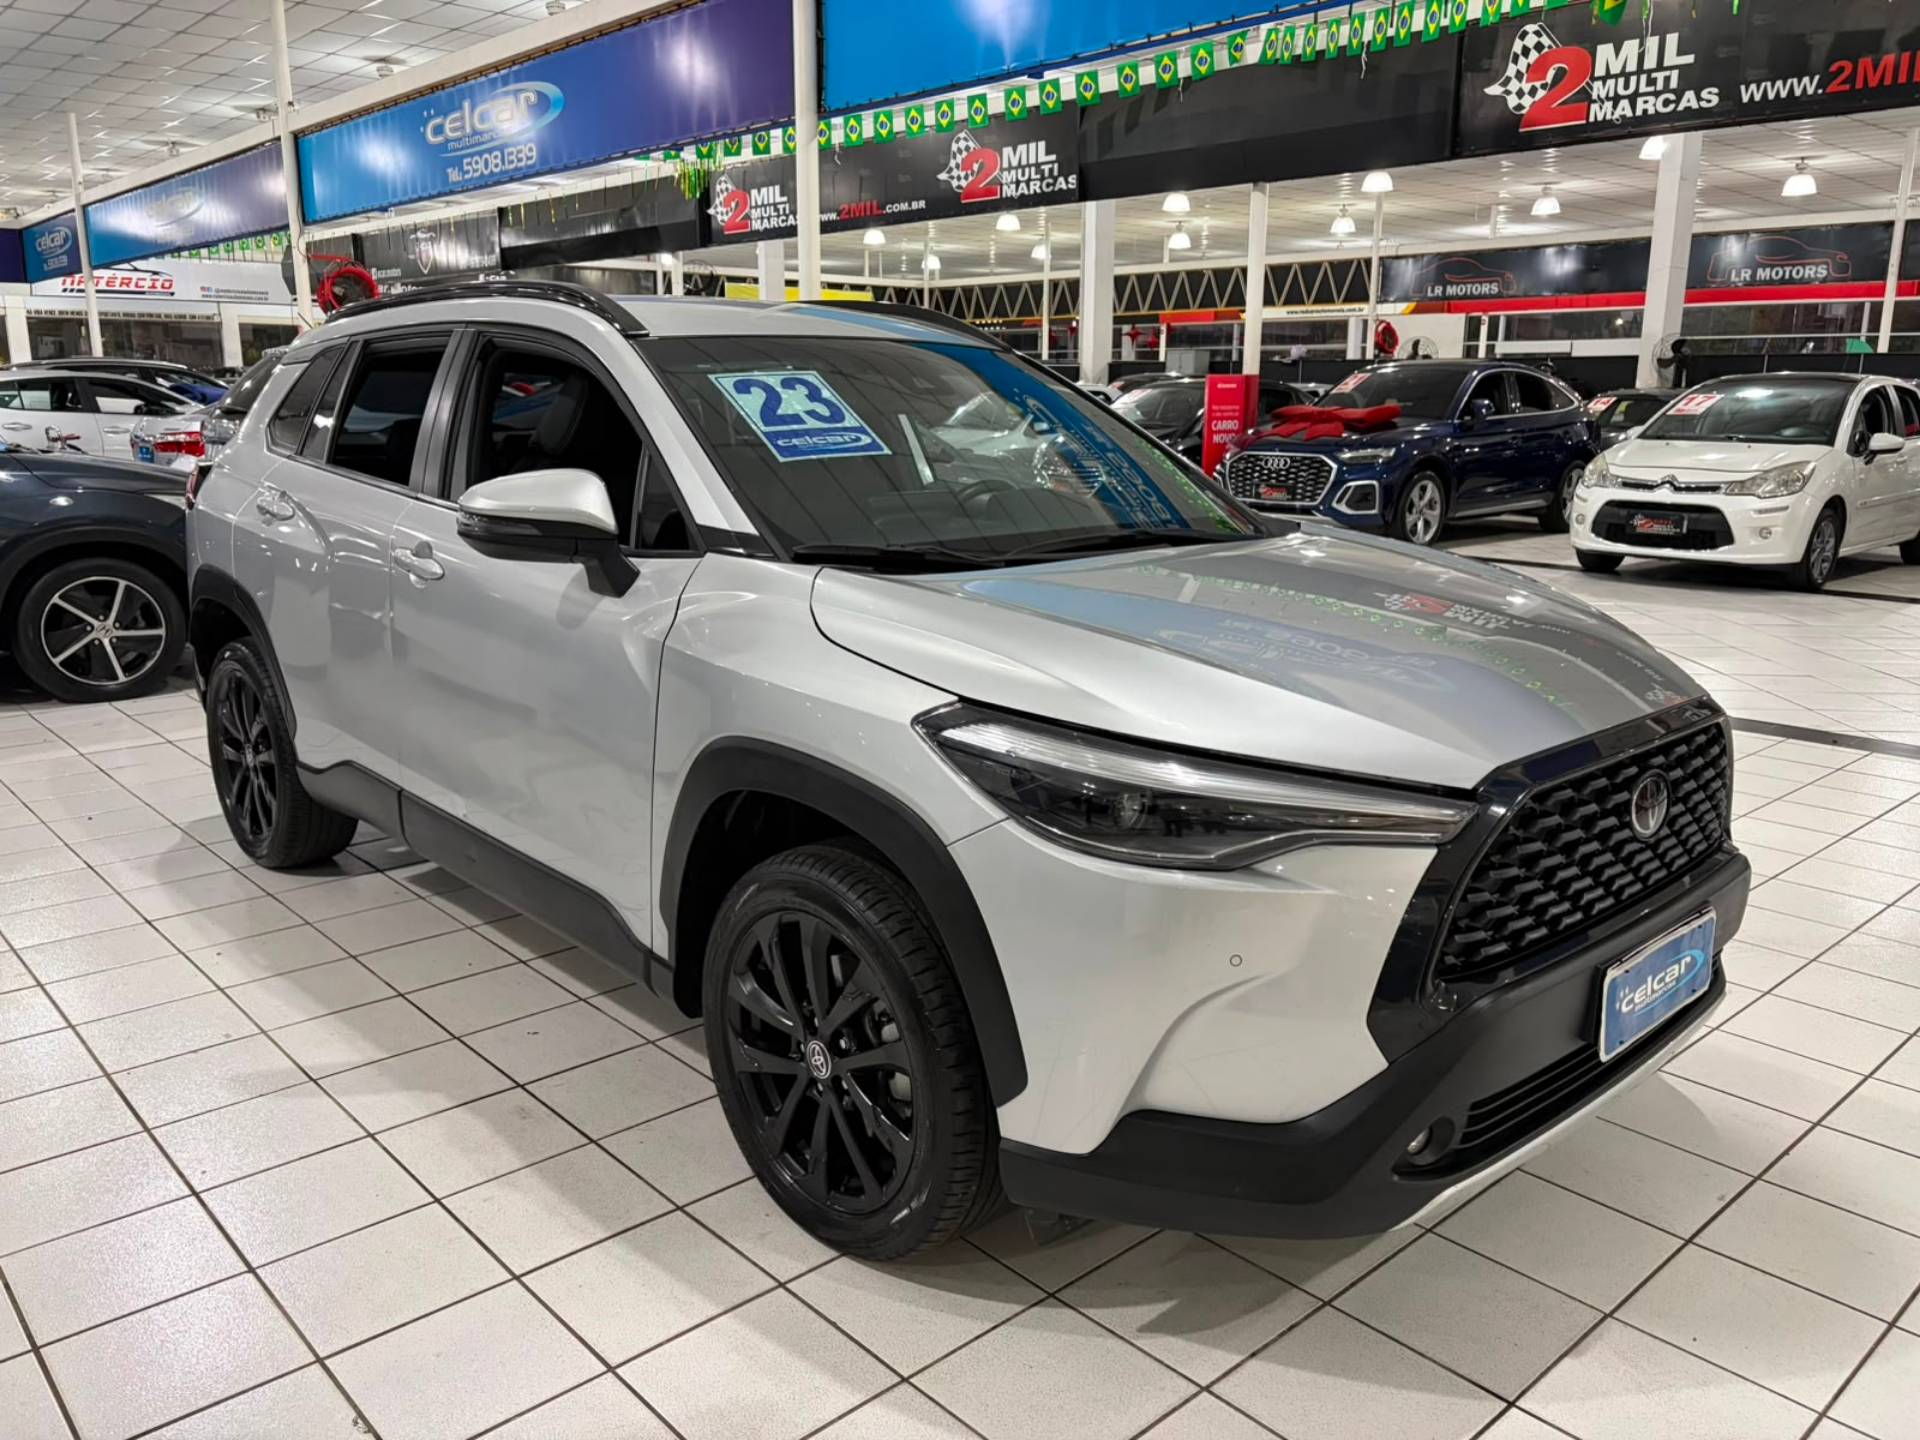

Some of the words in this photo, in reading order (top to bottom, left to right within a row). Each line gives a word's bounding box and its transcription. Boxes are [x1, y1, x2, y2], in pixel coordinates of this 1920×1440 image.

[1519, 46, 1592, 132] 2
[1594, 32, 1696, 78] MIL
[1592, 69, 1679, 99] MULTI
[424, 89, 538, 145] celcar
[1588, 87, 1720, 122] MARCAS
[463, 143, 537, 181] 5908.1339
[960, 148, 1000, 203] 2
[1002, 140, 1057, 169] MIL
[1002, 162, 1059, 184] MULTI
[1002, 174, 1077, 199] MARCAS
[723, 189, 750, 234] 2
[750, 184, 788, 207] MIL
[751, 203, 789, 220] MULTI
[752, 214, 798, 231] MARCA
[1731, 268, 1752, 282] LR
[1756, 264, 1828, 281] MOTORS
[1427, 285, 1443, 297] LR
[1445, 282, 1499, 297] MOTORS
[732, 377, 846, 427] 23
[777, 434, 857, 447] celcar
[1211, 420, 1239, 431] CARRO
[1621, 955, 1692, 1013] celcar
